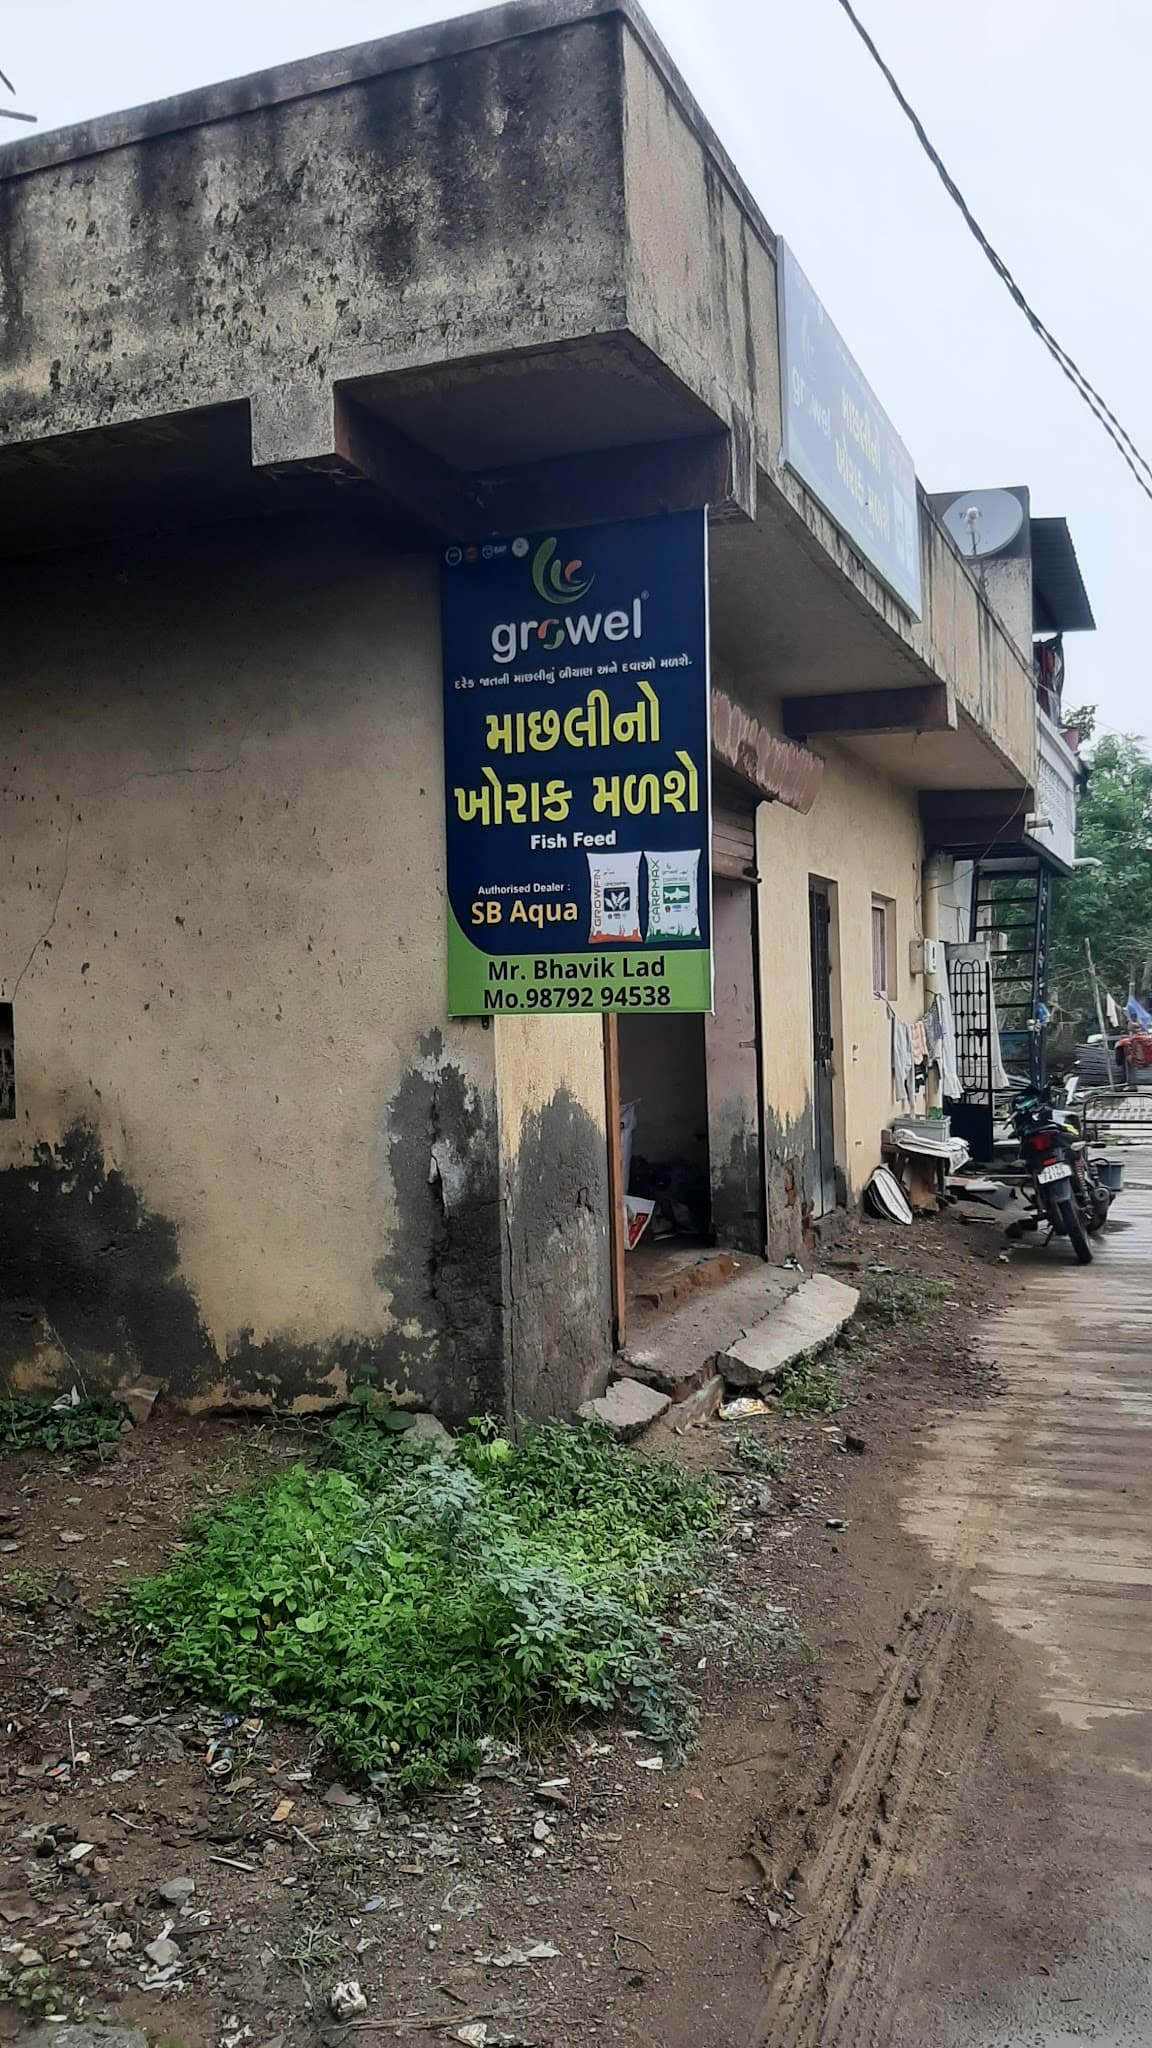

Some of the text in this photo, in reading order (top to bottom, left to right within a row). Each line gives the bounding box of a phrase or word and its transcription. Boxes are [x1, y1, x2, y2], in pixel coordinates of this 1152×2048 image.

[491, 598, 642, 664] growel
[454, 676, 475, 690] દરેક
[597, 660, 618, 675] અને
[622, 656, 656, 673] દવાઓ
[485, 680, 660, 754] માછલીનો
[454, 750, 699, 825] ખોરાક મળશે
[530, 830, 617, 850] Fish Feed
[477, 882, 531, 895] Authorised
[593, 868, 602, 927] GROWFIN
[650, 857, 661, 925] CARPMAX
[471, 899, 579, 929] SB Aqua
[488, 955, 666, 981] Mr. Bhavik Lad
[483, 985, 671, 1009] Mo.98792 94538
